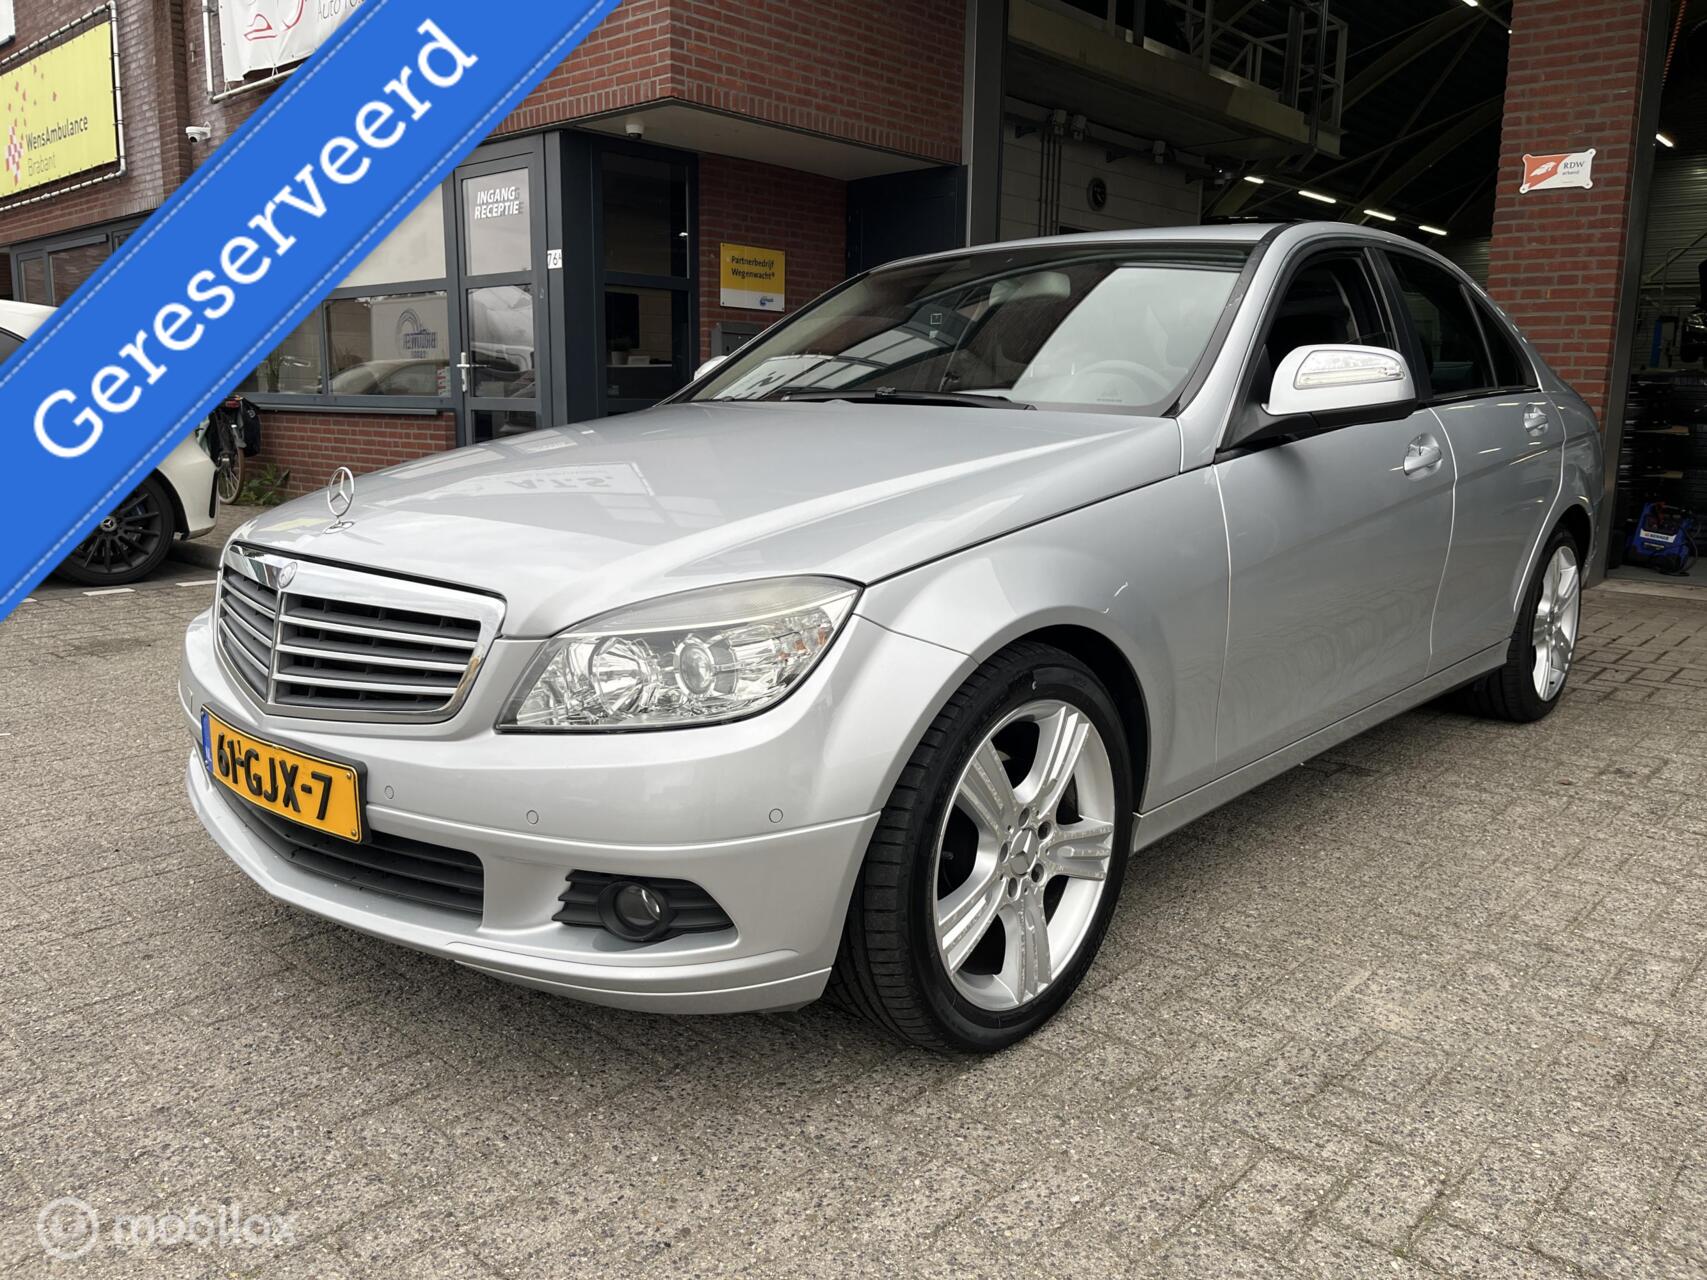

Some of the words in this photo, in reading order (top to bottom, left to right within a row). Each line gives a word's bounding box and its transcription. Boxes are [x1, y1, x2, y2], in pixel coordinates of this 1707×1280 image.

[25, 115, 88, 152] WensAmbulance
[27, 152, 57, 177] Brabant
[1563, 161, 1585, 169] RDW
[476, 186, 516, 205] INGANG
[474, 201, 520, 220] RECEPTIE
[731, 255, 775, 271] Partnerbedrijf
[217, 731, 333, 821] 61-GJX-7
